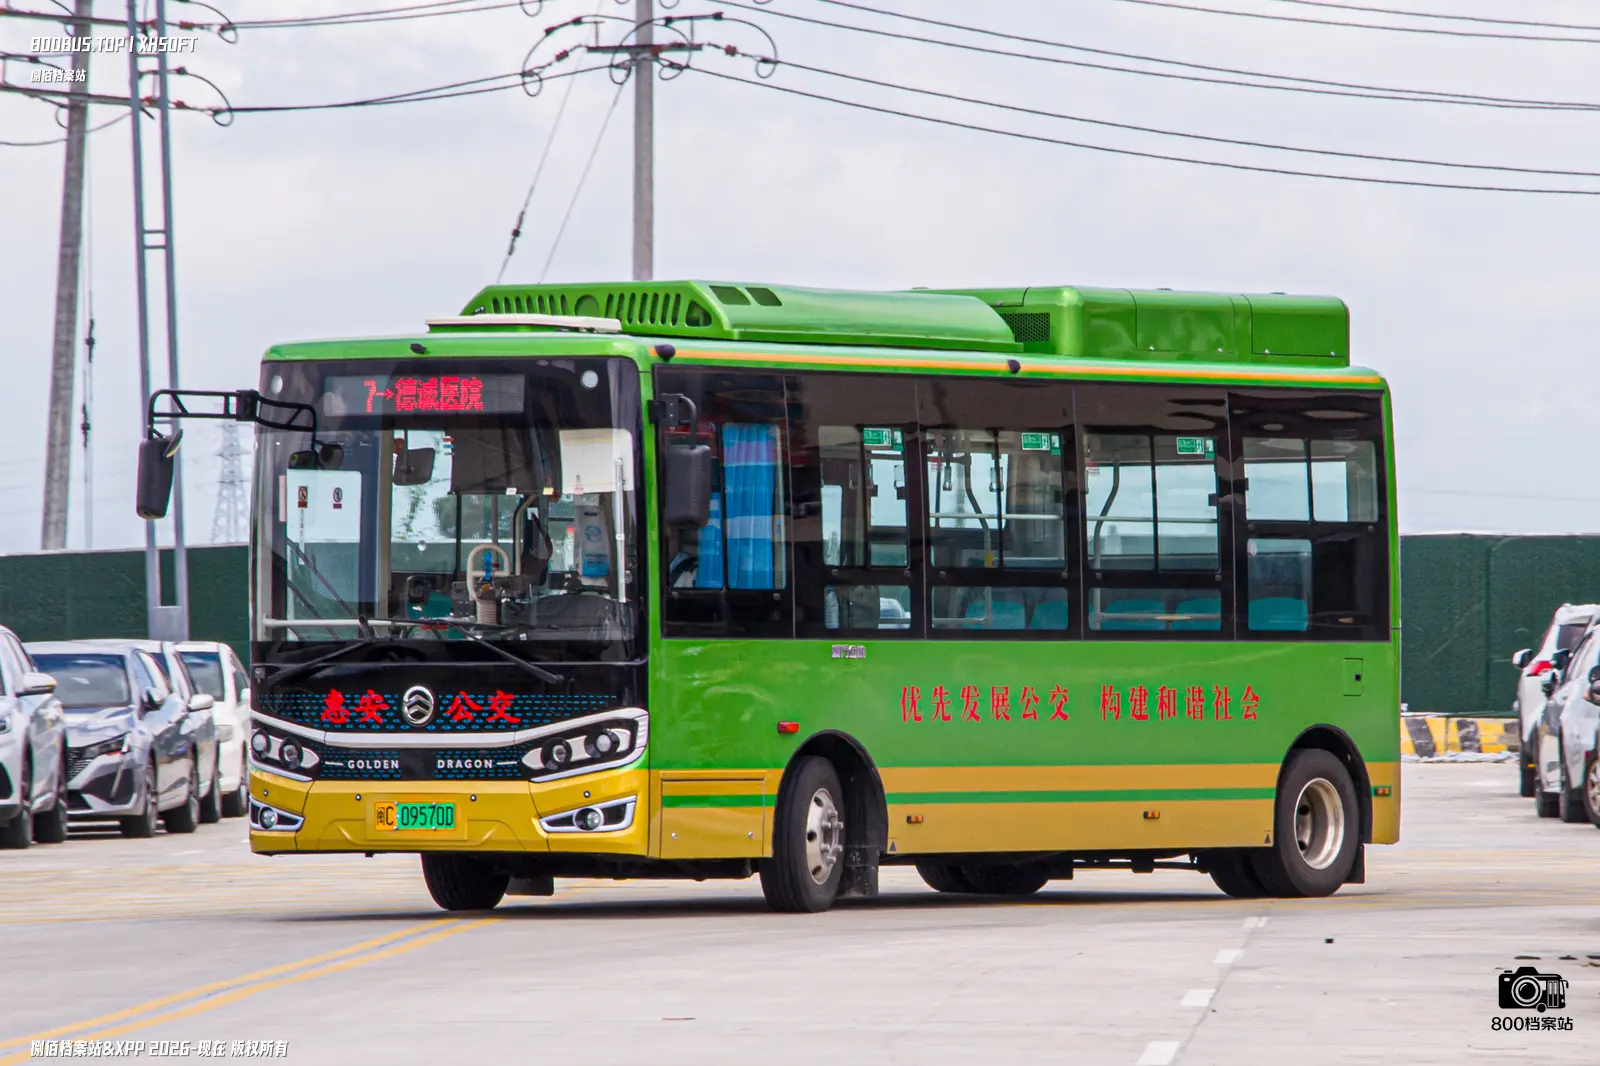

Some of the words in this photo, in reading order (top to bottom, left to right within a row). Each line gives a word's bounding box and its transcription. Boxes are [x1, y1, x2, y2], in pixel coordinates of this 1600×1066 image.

[363, 379, 377, 413] 7
[320, 688, 389, 724] 惠安
[445, 690, 521, 723] 公交
[900, 684, 1070, 723] 优先发展公交
[1100, 684, 1260, 722] 构建和谐社会
[347, 760, 399, 770] GOLDEN
[437, 759, 493, 769] DRAGON
